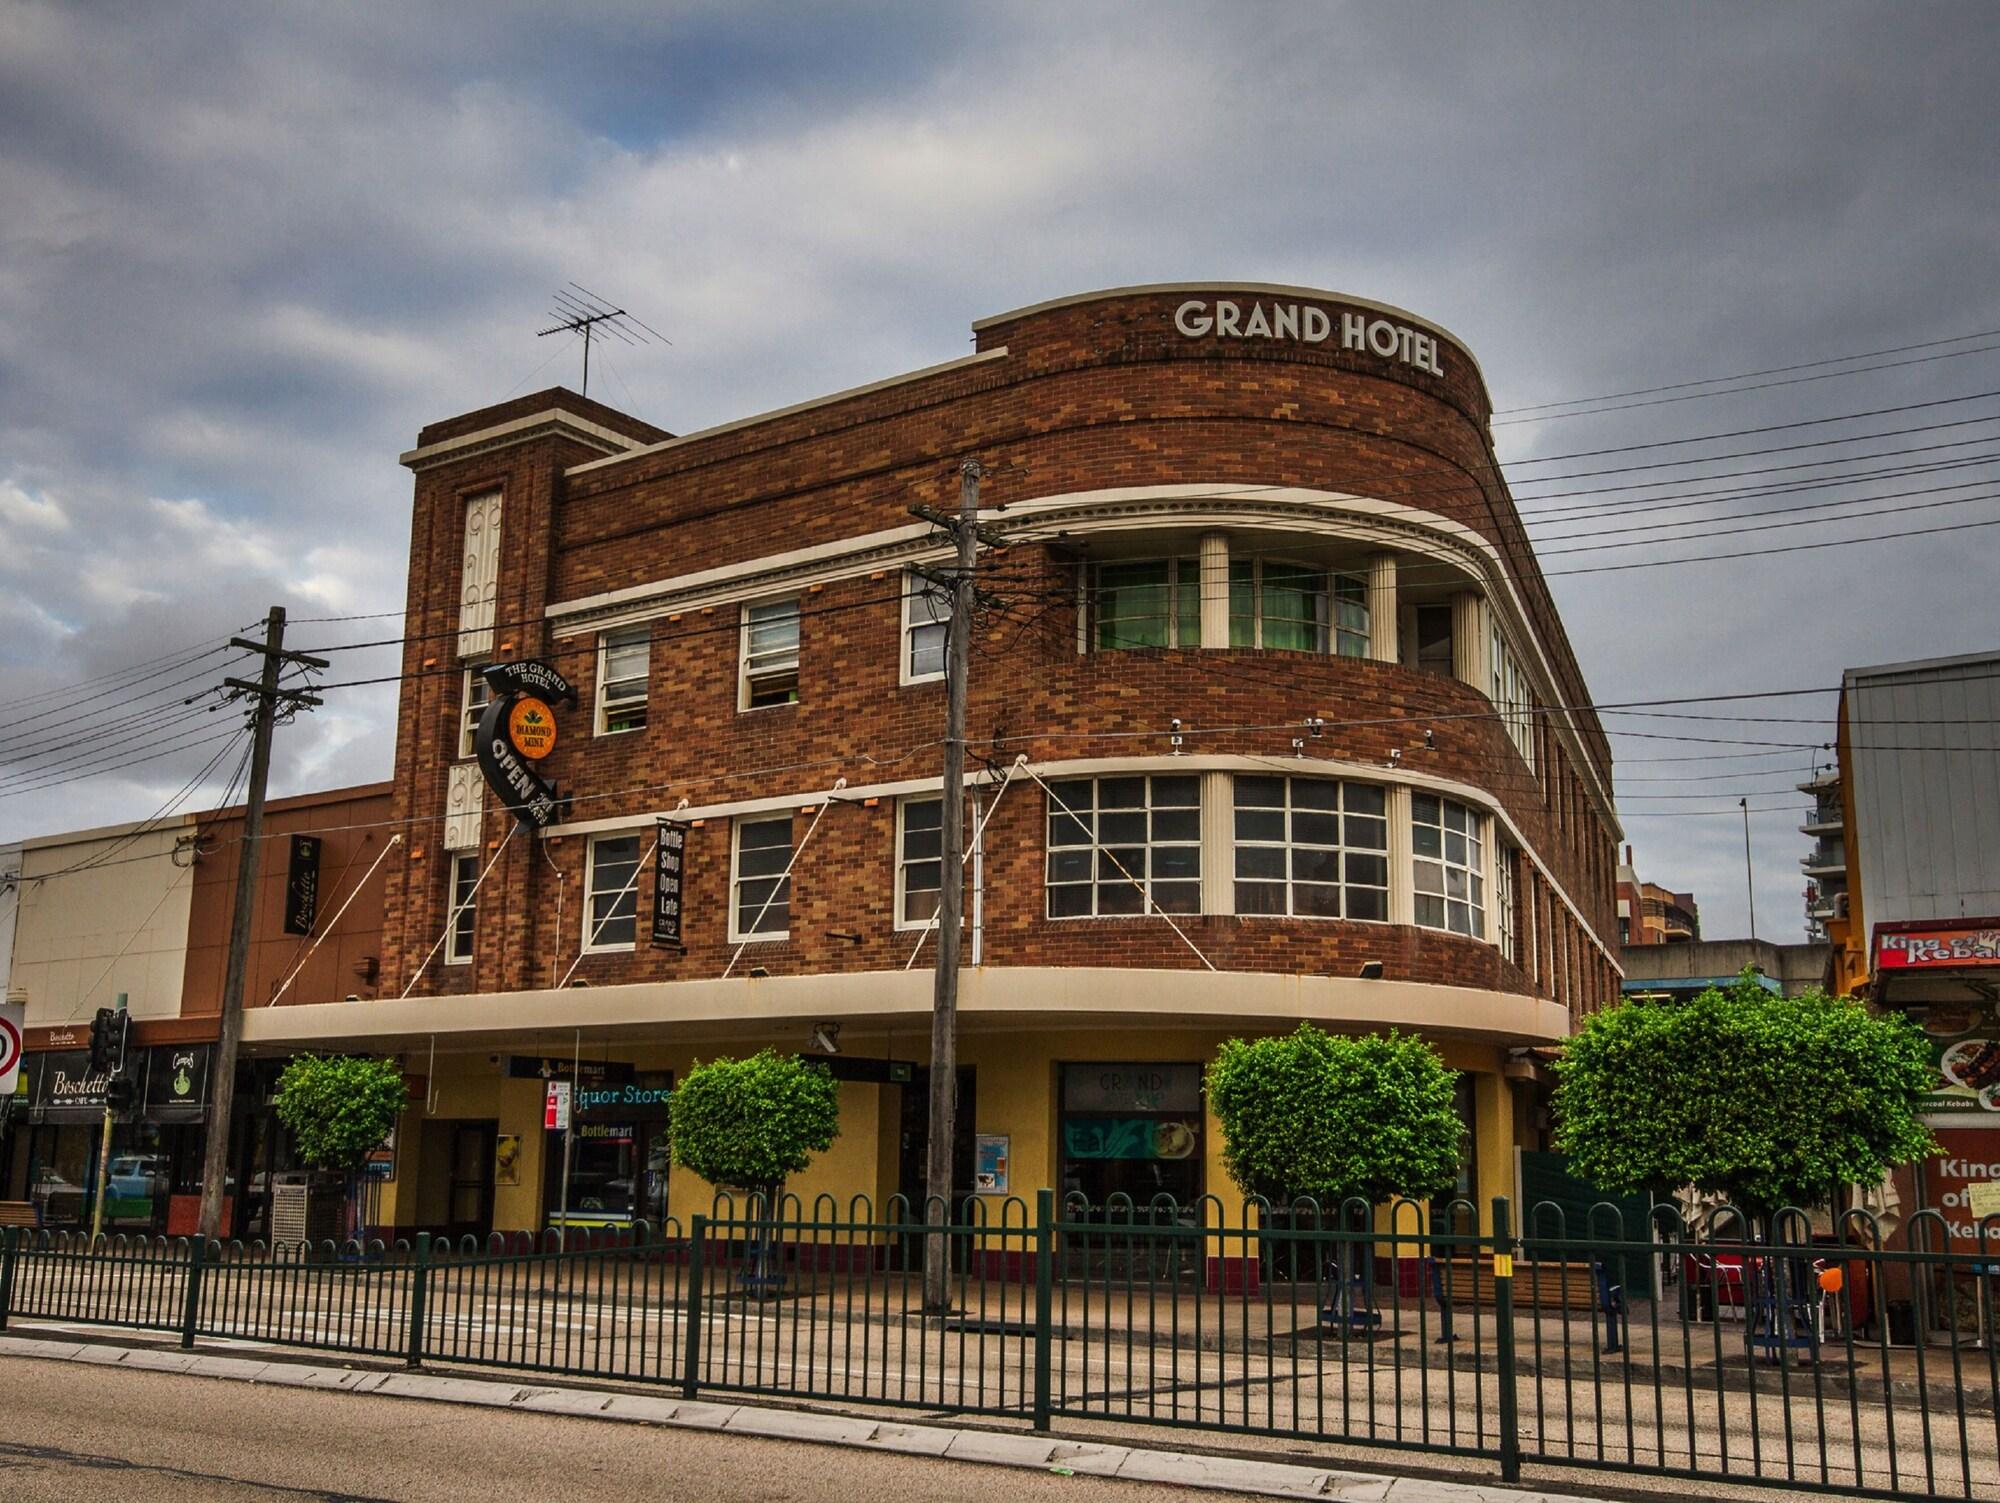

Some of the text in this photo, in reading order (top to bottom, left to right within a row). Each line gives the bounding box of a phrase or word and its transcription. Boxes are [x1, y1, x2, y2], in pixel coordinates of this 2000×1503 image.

[1174, 300, 1444, 378] GRAND HOTEL
[505, 662, 567, 692] THE GRAND
[521, 674, 551, 690] HOTEL
[516, 725, 552, 738] DIAMOND
[523, 736, 544, 748] MINE
[491, 738, 536, 800] OPEN
[660, 828, 683, 850] Bottle
[661, 851, 680, 873] Shop
[660, 873, 679, 894] Open
[660, 896, 679, 916] Late
[1881, 934, 1940, 950] King
[53, 1070, 109, 1095] Boschetto
[1100, 1074, 1162, 1091] GRND
[624, 1085, 673, 1104] Store
[581, 1125, 633, 1138] Bottlemart
